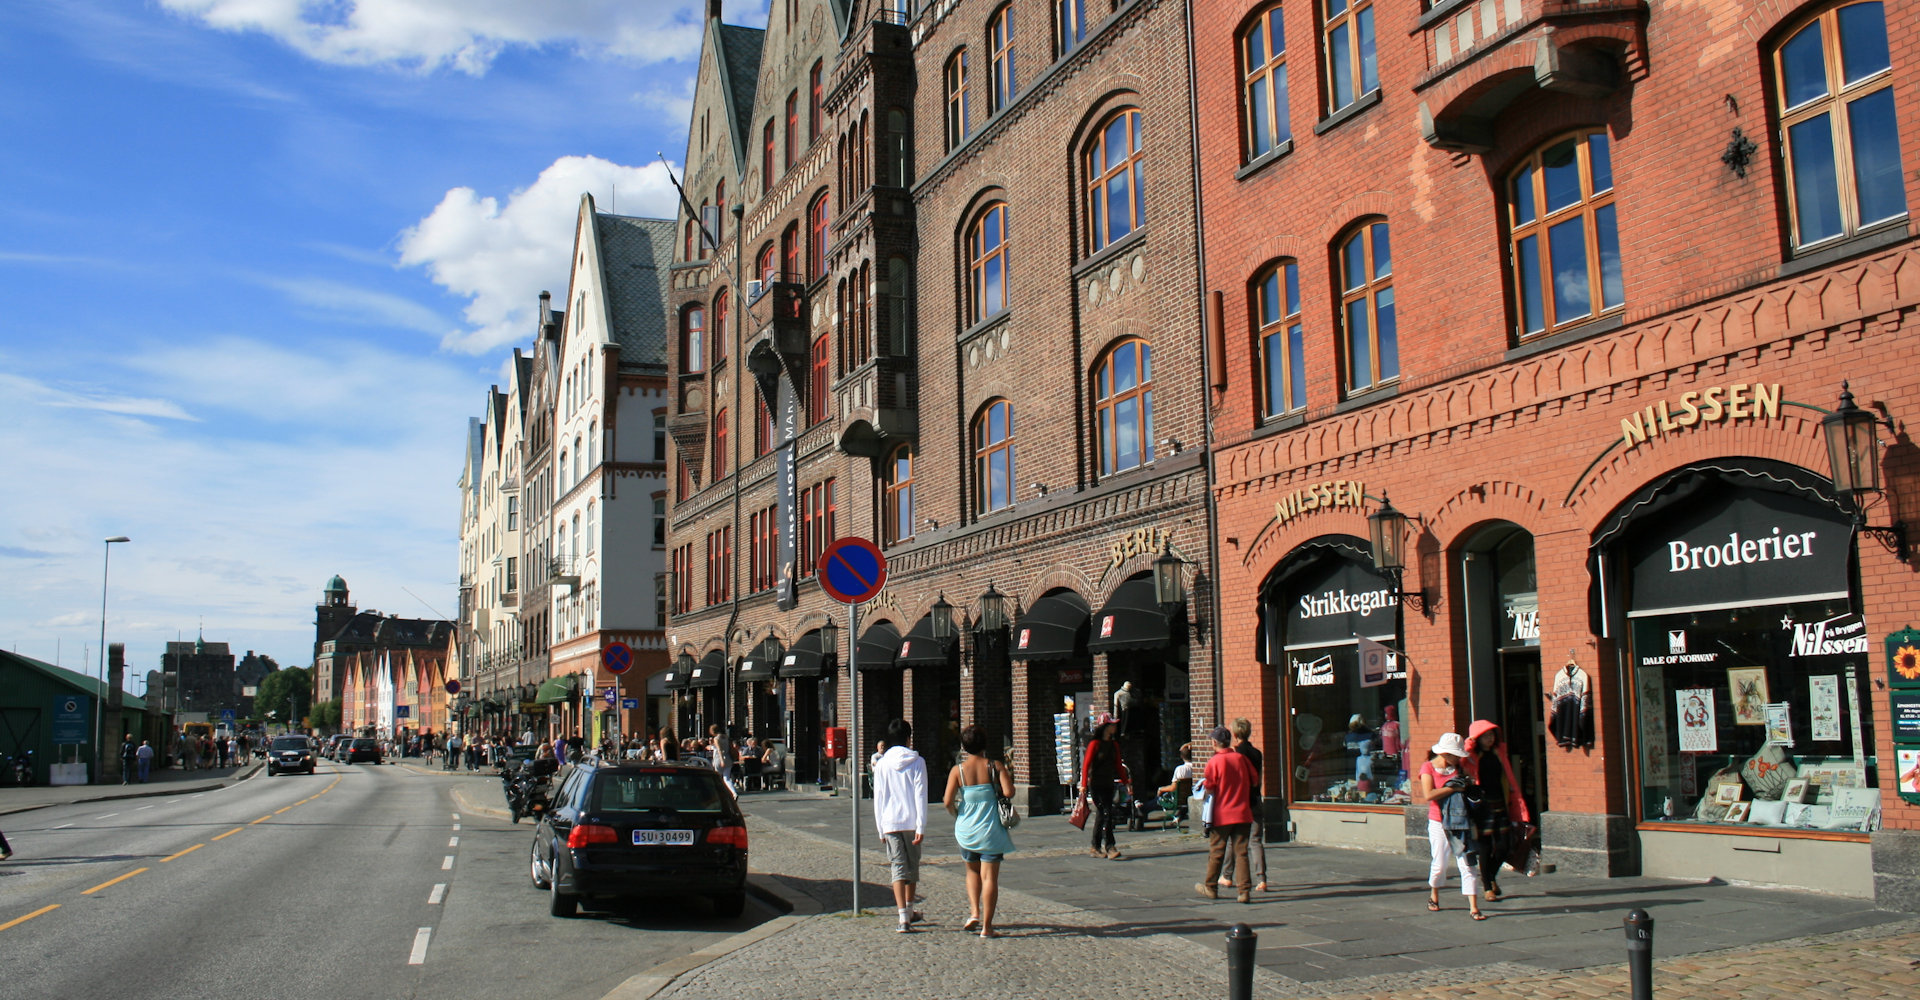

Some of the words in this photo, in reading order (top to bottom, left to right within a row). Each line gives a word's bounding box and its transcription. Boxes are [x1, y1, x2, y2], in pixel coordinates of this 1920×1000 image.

[1620, 384, 1780, 447] NILSSEN
[1275, 480, 1363, 524] NILSSEN
[1668, 527, 1816, 572] Broderier
[1788, 622, 1869, 657] Nilssen
[1296, 662, 1334, 686] Nilssen
[1643, 656, 1665, 665] DALE
[1666, 655, 1678, 664] OF
[1679, 653, 1715, 663] NORWAY
[641, 832, 654, 841] SU
[659, 832, 690, 841] 30499
